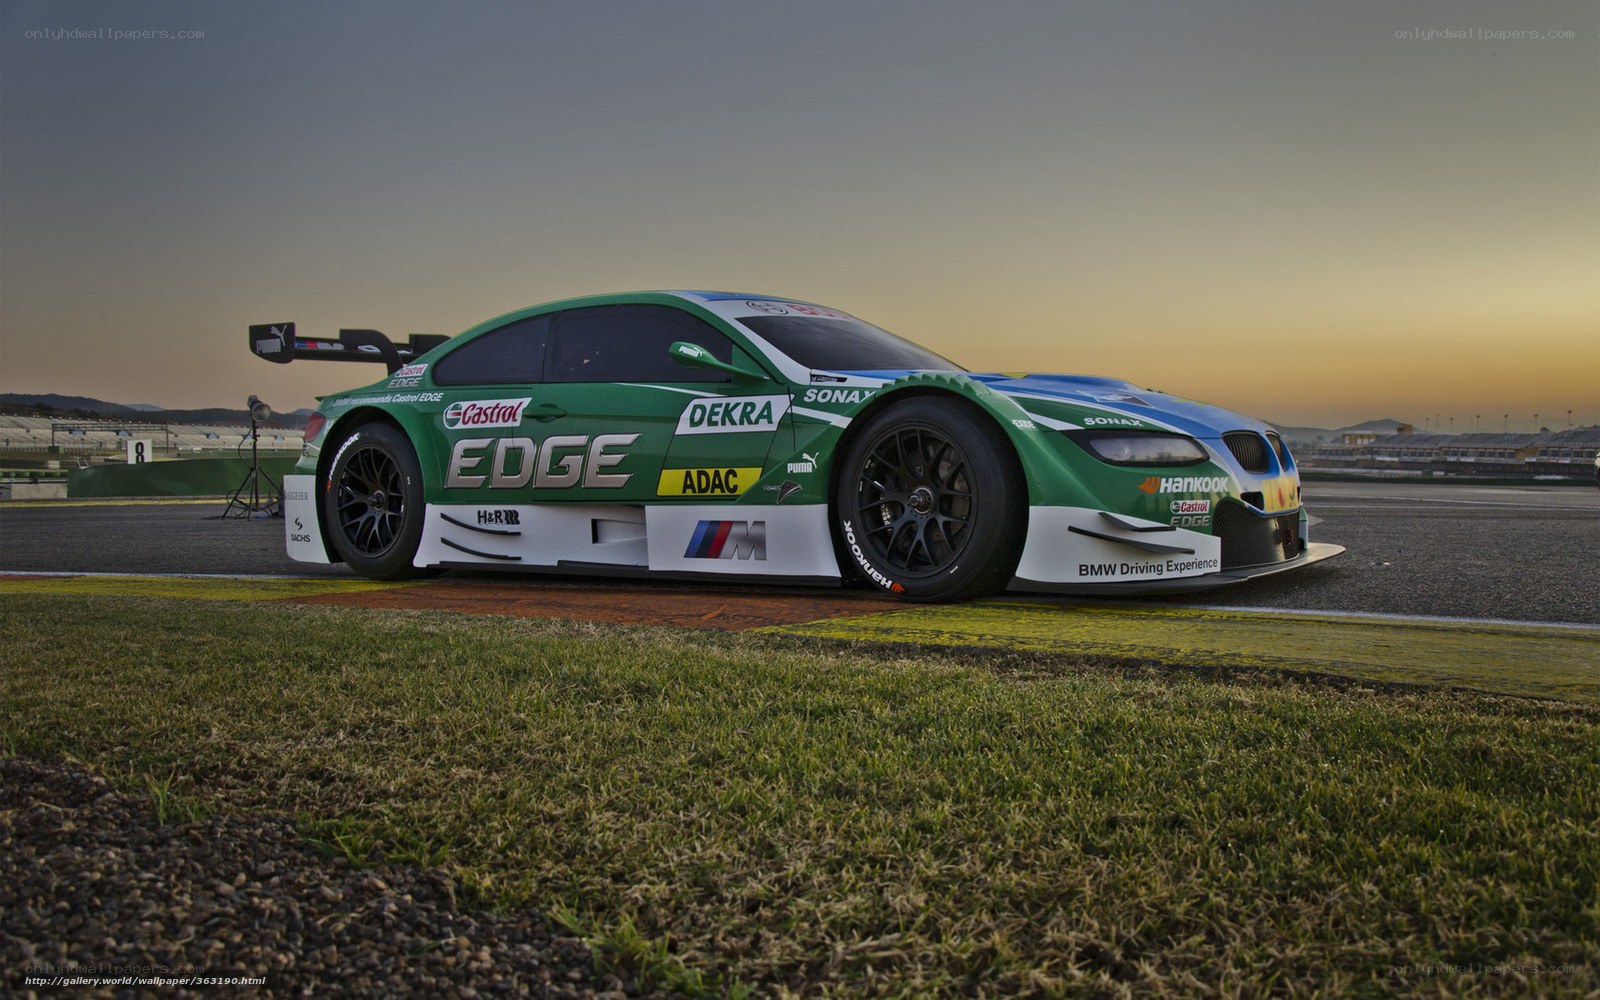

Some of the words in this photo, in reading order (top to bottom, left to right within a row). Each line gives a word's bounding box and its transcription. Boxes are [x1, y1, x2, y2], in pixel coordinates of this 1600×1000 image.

[386, 377, 422, 389] EDGE
[392, 393, 420, 402] Castrol
[419, 392, 444, 402] EDGE
[803, 388, 877, 404] SONAX
[461, 401, 524, 426] Castrol
[689, 401, 774, 428] DEKRA
[1083, 416, 1144, 427] SONAX
[134, 441, 145, 464] 8
[444, 432, 643, 489] EDGE
[787, 462, 813, 474] PUMA
[681, 468, 739, 495] ADAC
[1180, 501, 1209, 514] Castrol
[1170, 515, 1211, 528] EDGE
[290, 533, 311, 543] SACHS
[716, 520, 767, 561] M
[1078, 563, 1118, 577] BMW
[1120, 561, 1164, 576] Driving
[1166, 558, 1218, 574] Experience
